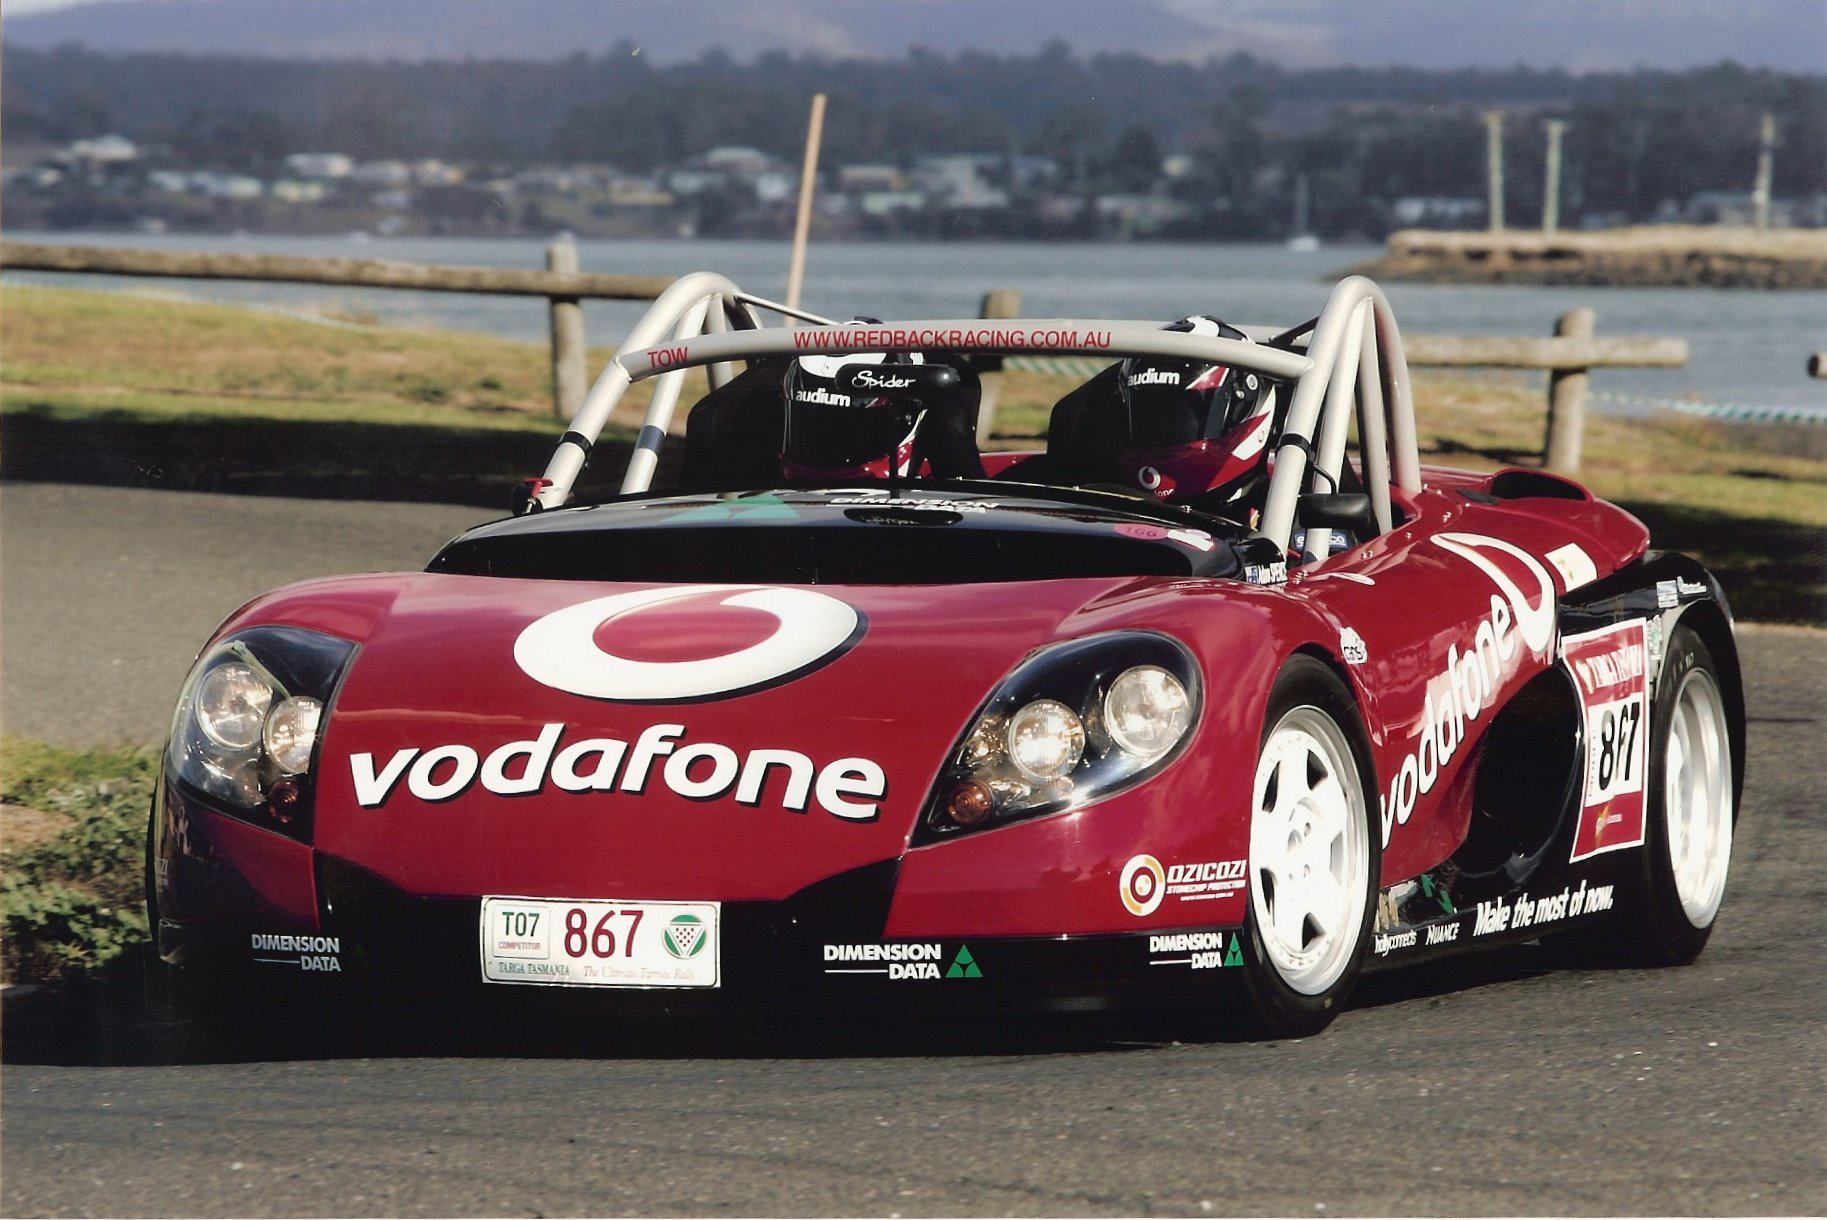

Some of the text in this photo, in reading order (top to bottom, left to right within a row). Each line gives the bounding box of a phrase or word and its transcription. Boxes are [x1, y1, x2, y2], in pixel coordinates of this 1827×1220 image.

[794, 330, 1111, 349] WWW.REDBACKRACING.COM.AU
[648, 347, 688, 369] TOW
[852, 370, 917, 390] Spider
[1127, 368, 1181, 387] audium
[796, 388, 851, 408] audium
[1380, 594, 1516, 851] vodafone
[350, 722, 887, 820] vodafone
[1166, 859, 1248, 884] OZICOZI
[1473, 896, 1510, 937] Make
[1512, 893, 1536, 928] the
[1535, 887, 1570, 923] most
[1568, 879, 1587, 916] of
[501, 911, 540, 937] T07
[564, 908, 644, 959] 867
[251, 934, 340, 953] DIMENSION
[823, 944, 942, 961] DIMENSION
[1149, 932, 1222, 953] DIMENSION
[300, 956, 342, 972] DATA
[1191, 951, 1222, 969] DATA
[889, 963, 941, 980] DATA
